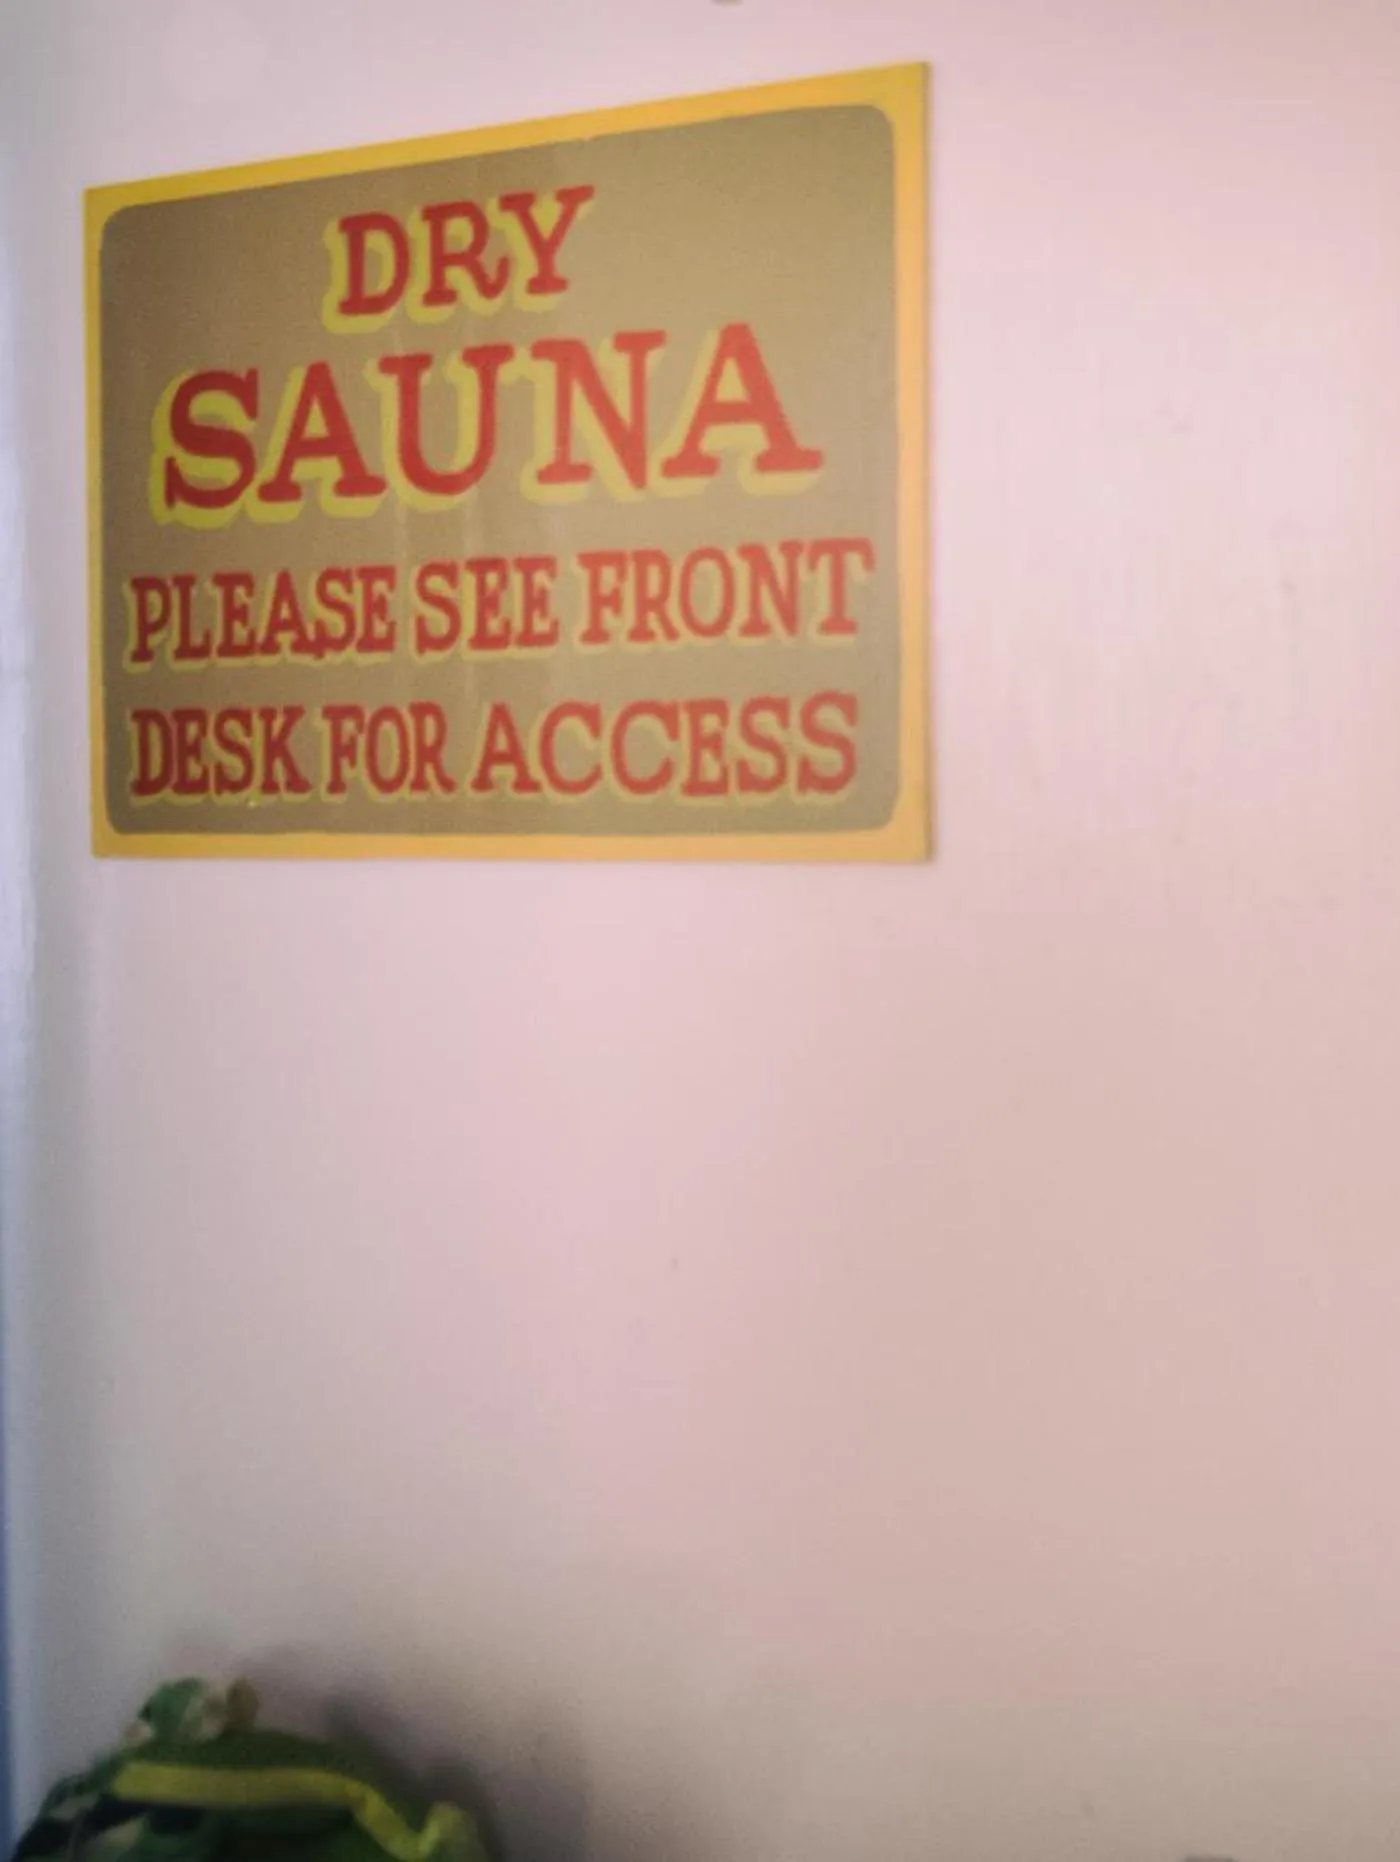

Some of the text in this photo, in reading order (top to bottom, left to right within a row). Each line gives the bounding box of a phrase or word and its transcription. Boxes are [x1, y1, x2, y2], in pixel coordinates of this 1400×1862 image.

[337, 185, 594, 316] DRY
[163, 322, 823, 509] SAUNA
[130, 537, 876, 663] PLEASE SEE FRONT
[131, 690, 859, 797] DESK FOR ACCESS
